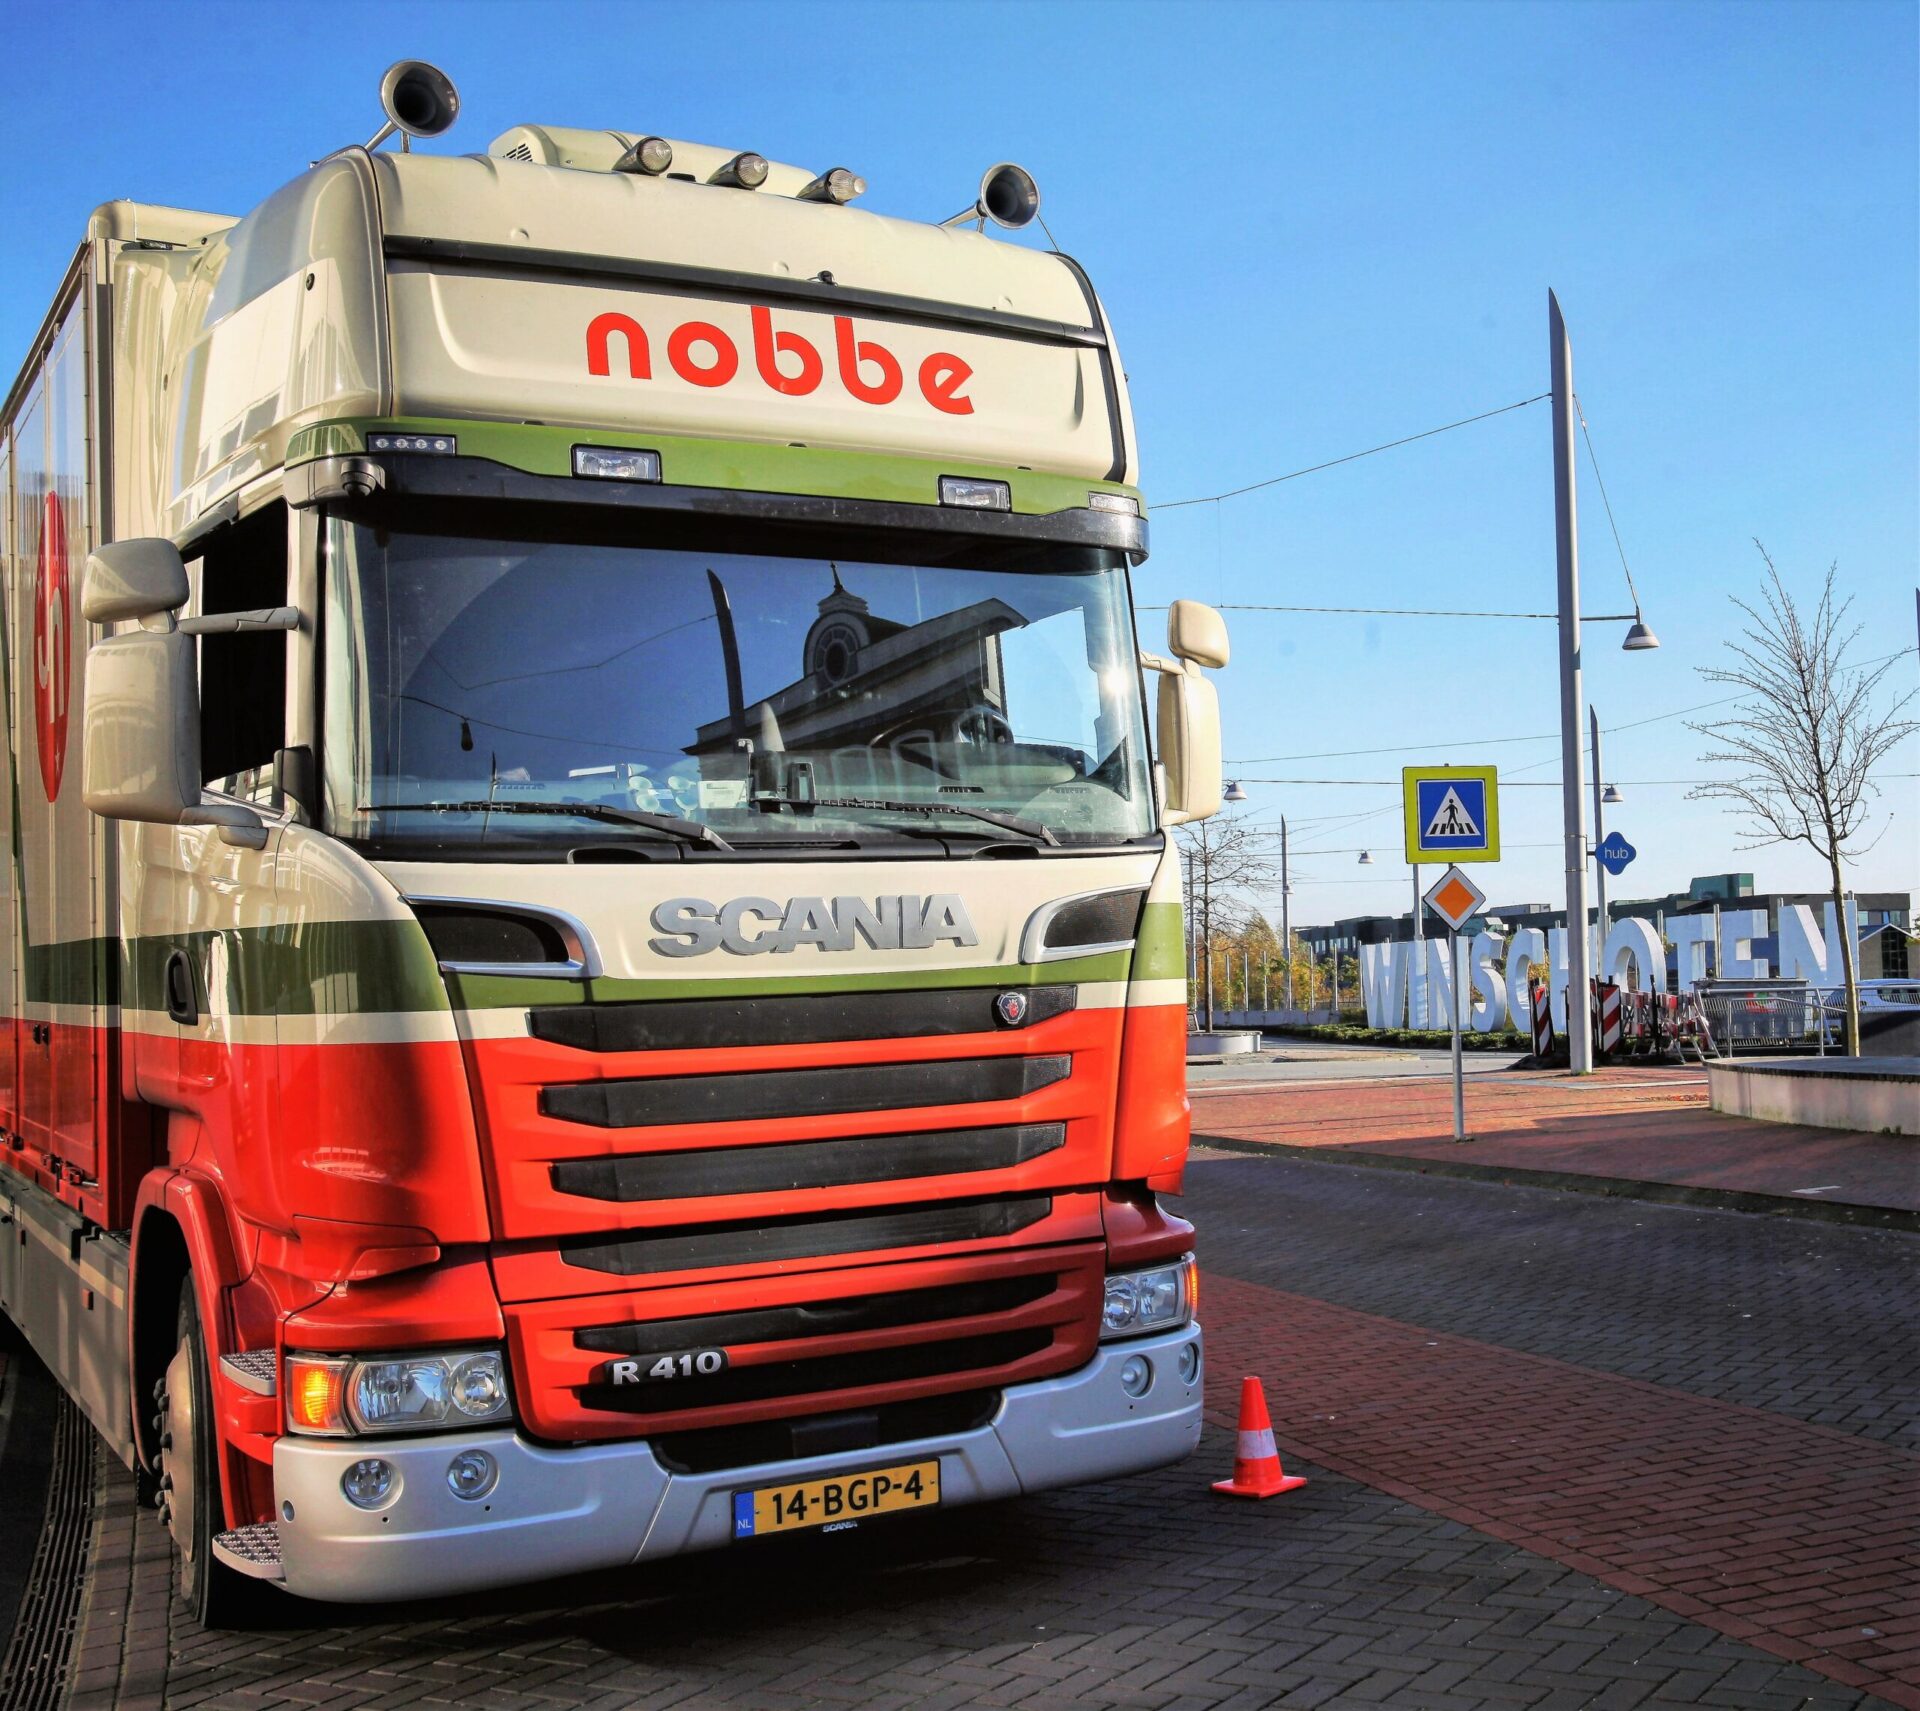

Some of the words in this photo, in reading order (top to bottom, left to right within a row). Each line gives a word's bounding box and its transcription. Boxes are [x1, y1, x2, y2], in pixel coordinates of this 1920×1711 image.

[586, 305, 975, 415] nobbe
[1604, 847, 1629, 859] hub
[648, 894, 981, 958] SCANIA
[613, 1361, 640, 1385] R
[649, 1351, 722, 1379] 410
[772, 1470, 924, 1525] 14-BGP-4
[737, 1519, 752, 1530] NL
[822, 1521, 858, 1533] SCANIA
